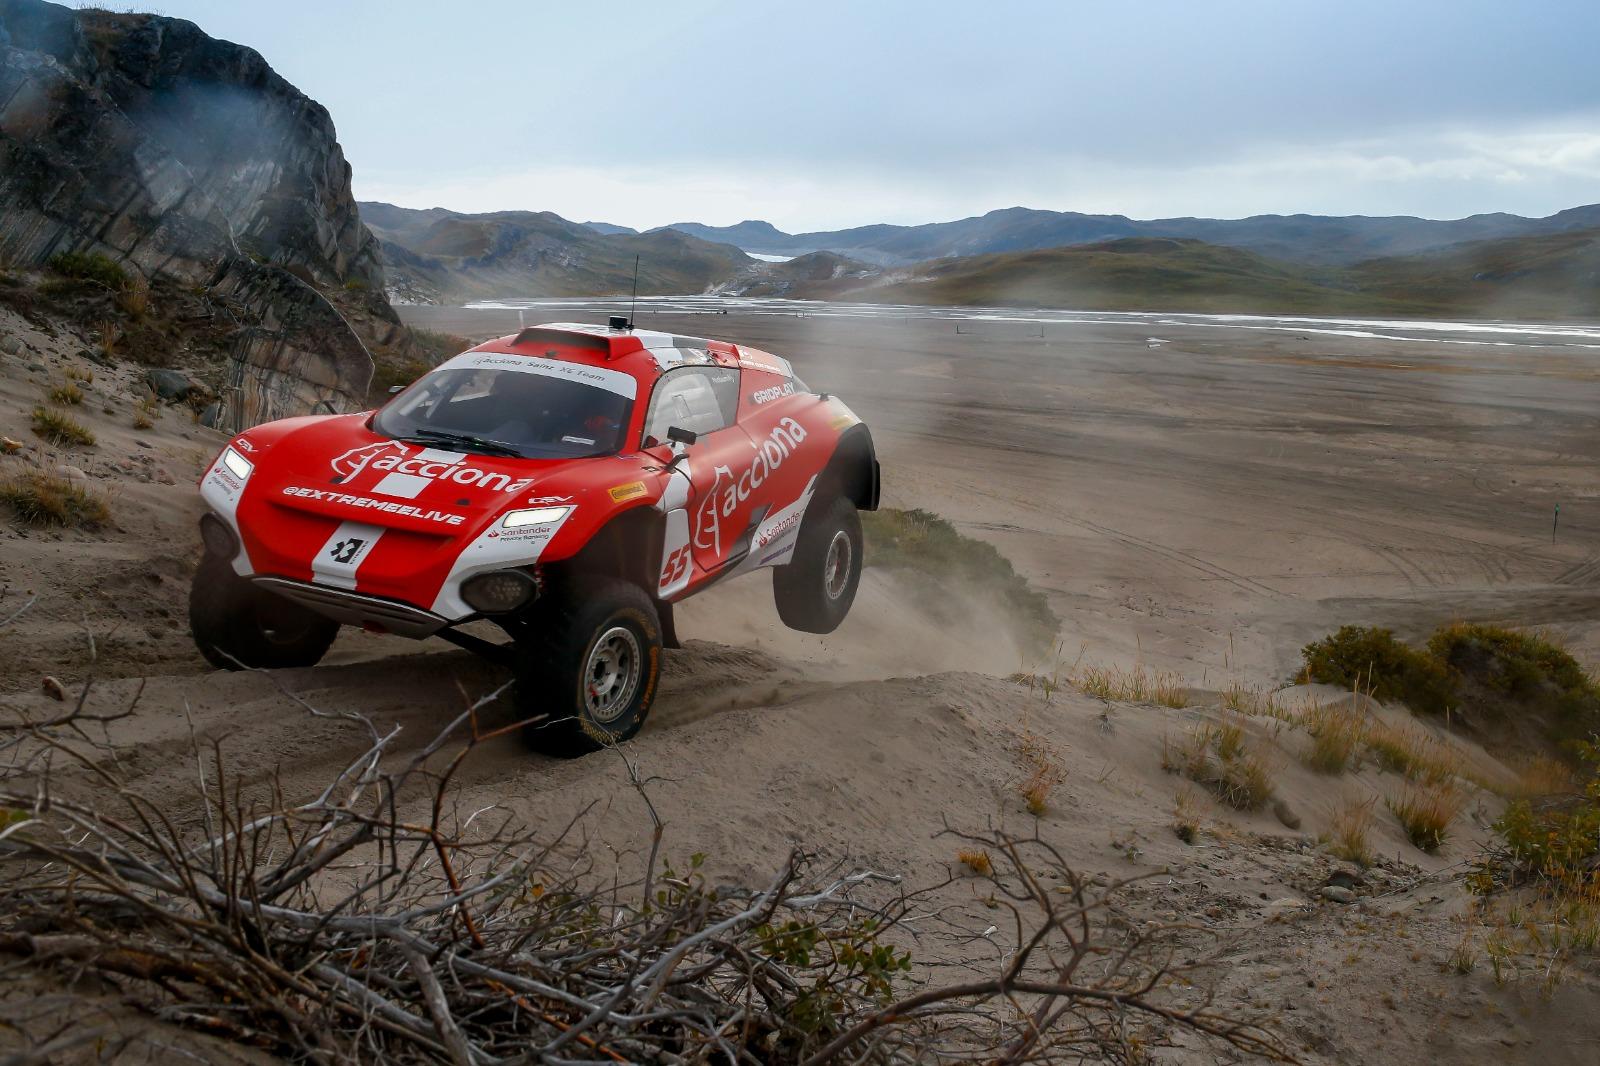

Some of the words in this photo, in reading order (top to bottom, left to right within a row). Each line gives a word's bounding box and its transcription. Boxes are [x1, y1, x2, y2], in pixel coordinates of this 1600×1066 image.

[527, 361, 554, 370] Sainz
[577, 370, 606, 382] Team
[753, 381, 795, 405] GRIDPLAY
[372, 453, 536, 493] acciona
[722, 416, 807, 518] acciona
[282, 486, 466, 526] @EXTREMEELIVE
[501, 526, 551, 536] Santander
[660, 543, 690, 588] 55
